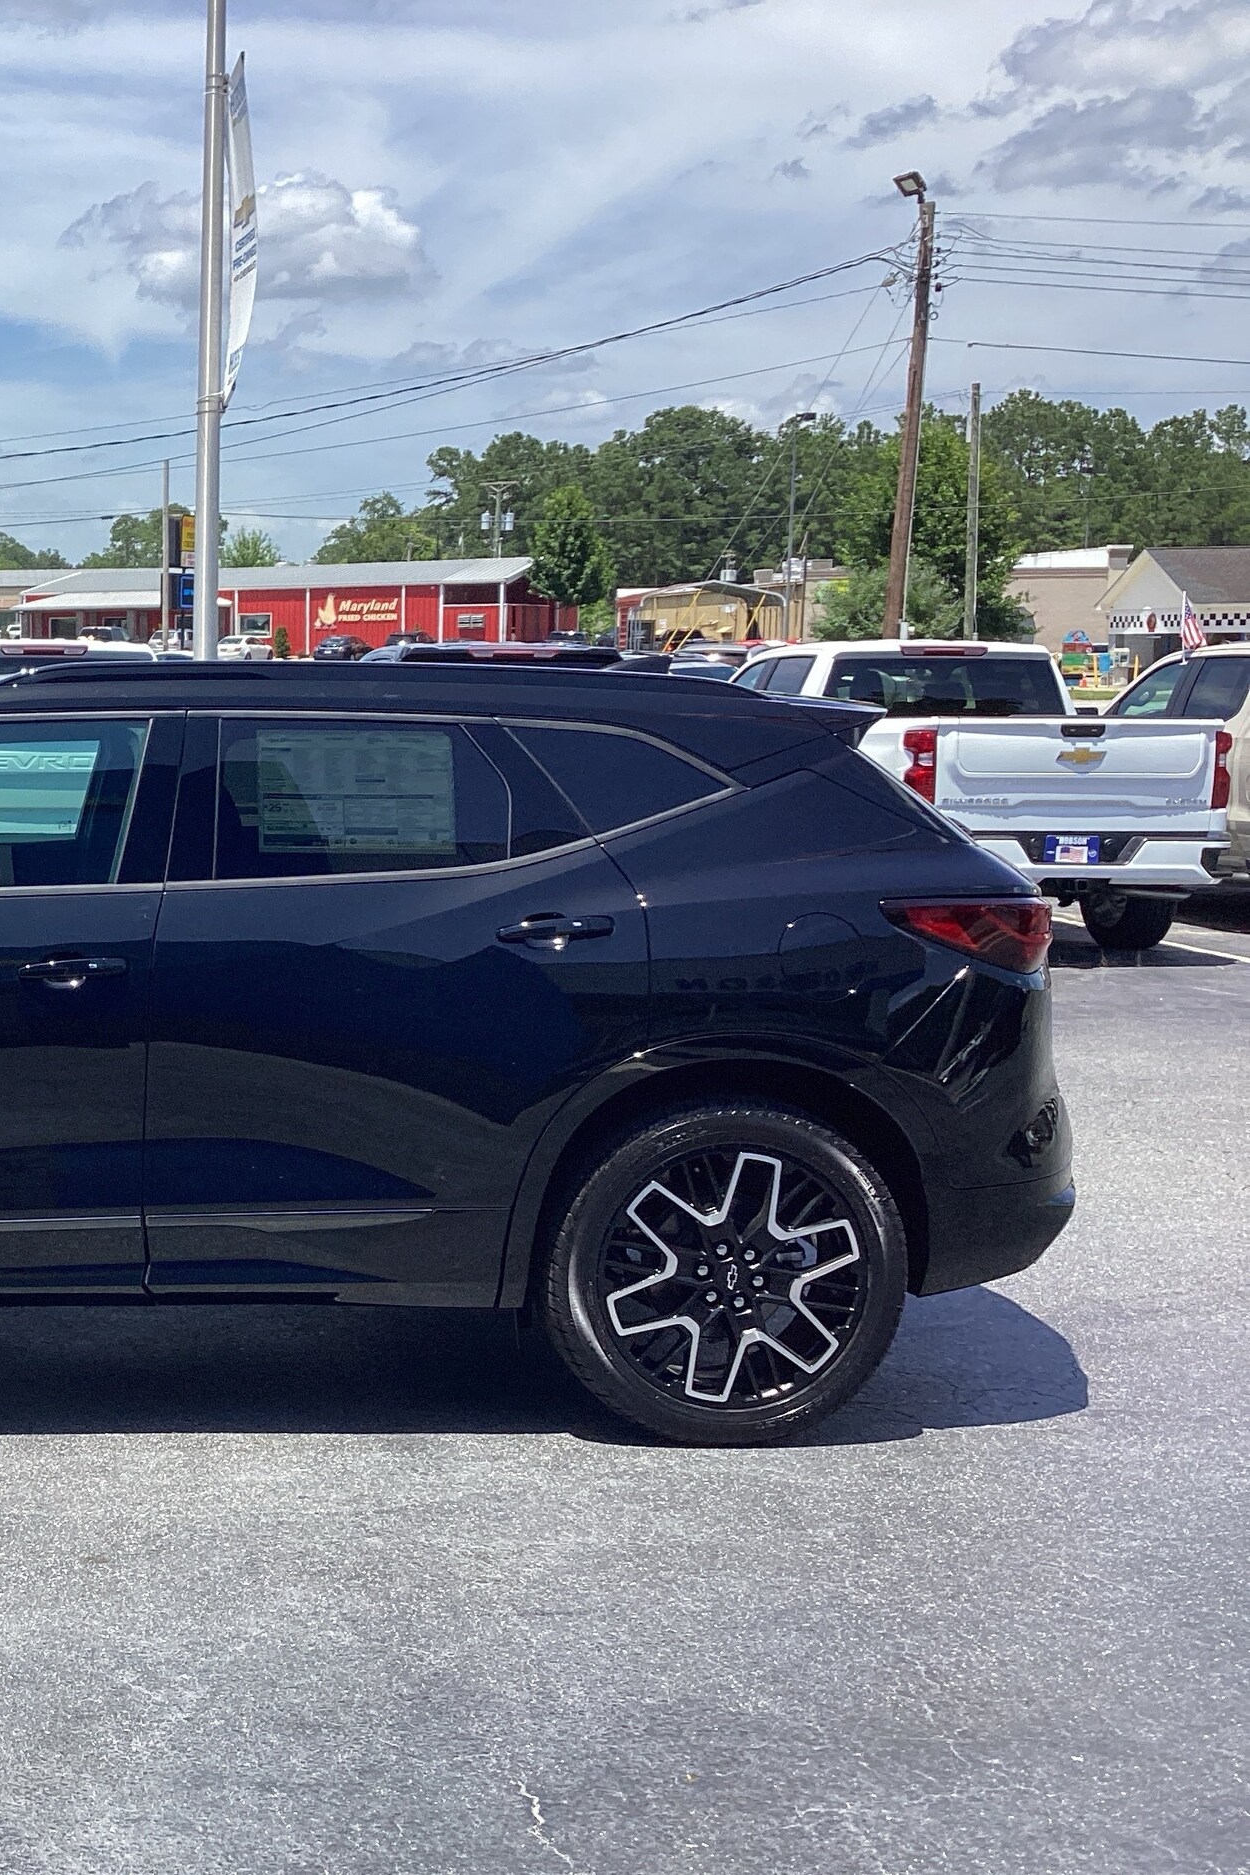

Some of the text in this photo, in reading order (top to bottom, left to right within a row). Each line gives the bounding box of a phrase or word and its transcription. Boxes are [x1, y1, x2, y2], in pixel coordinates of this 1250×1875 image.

[339, 598, 399, 614] Maryland
[337, 613, 398, 622] FRIED CHICKEN
